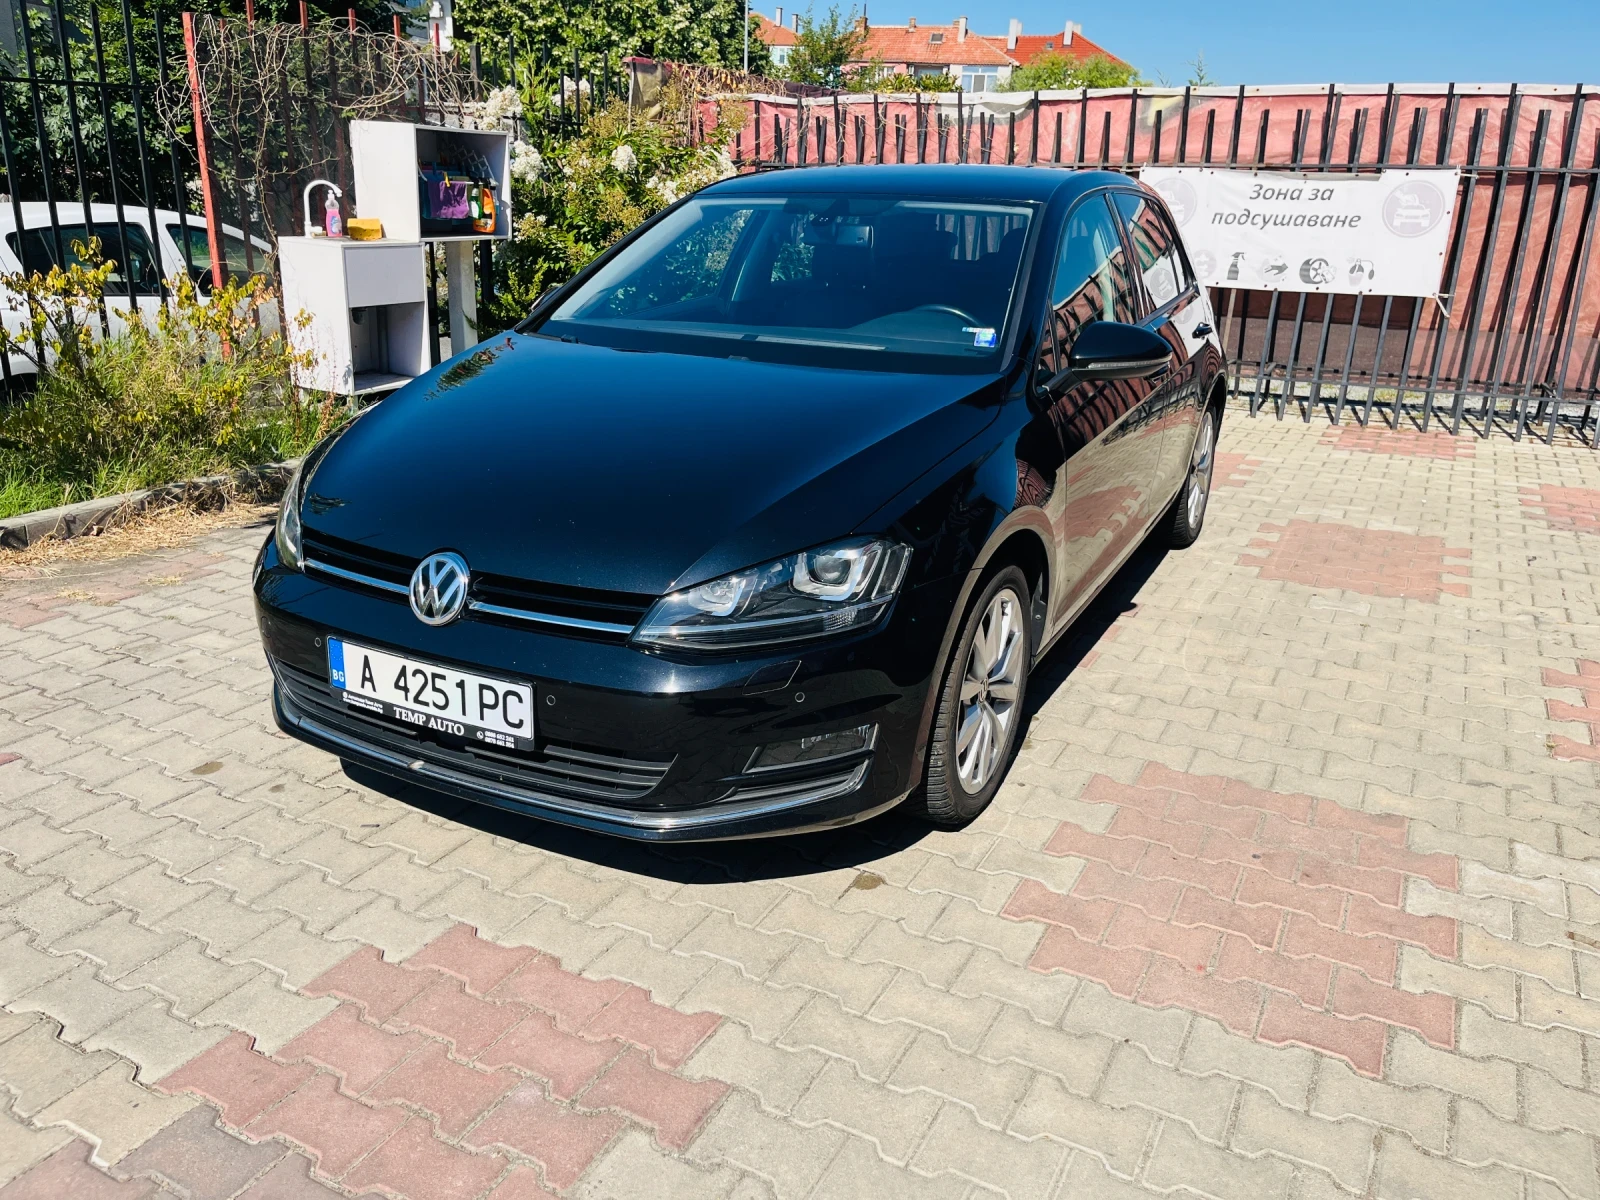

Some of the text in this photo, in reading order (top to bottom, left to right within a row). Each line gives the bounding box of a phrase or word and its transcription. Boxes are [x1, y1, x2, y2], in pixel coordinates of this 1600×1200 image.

[1249, 183, 1334, 201] Зона за
[1211, 209, 1362, 230] подсушаване
[412, 556, 462, 620] VW
[332, 669, 345, 683] BG
[360, 654, 377, 693] A
[393, 707, 465, 736] TEMP AUTO
